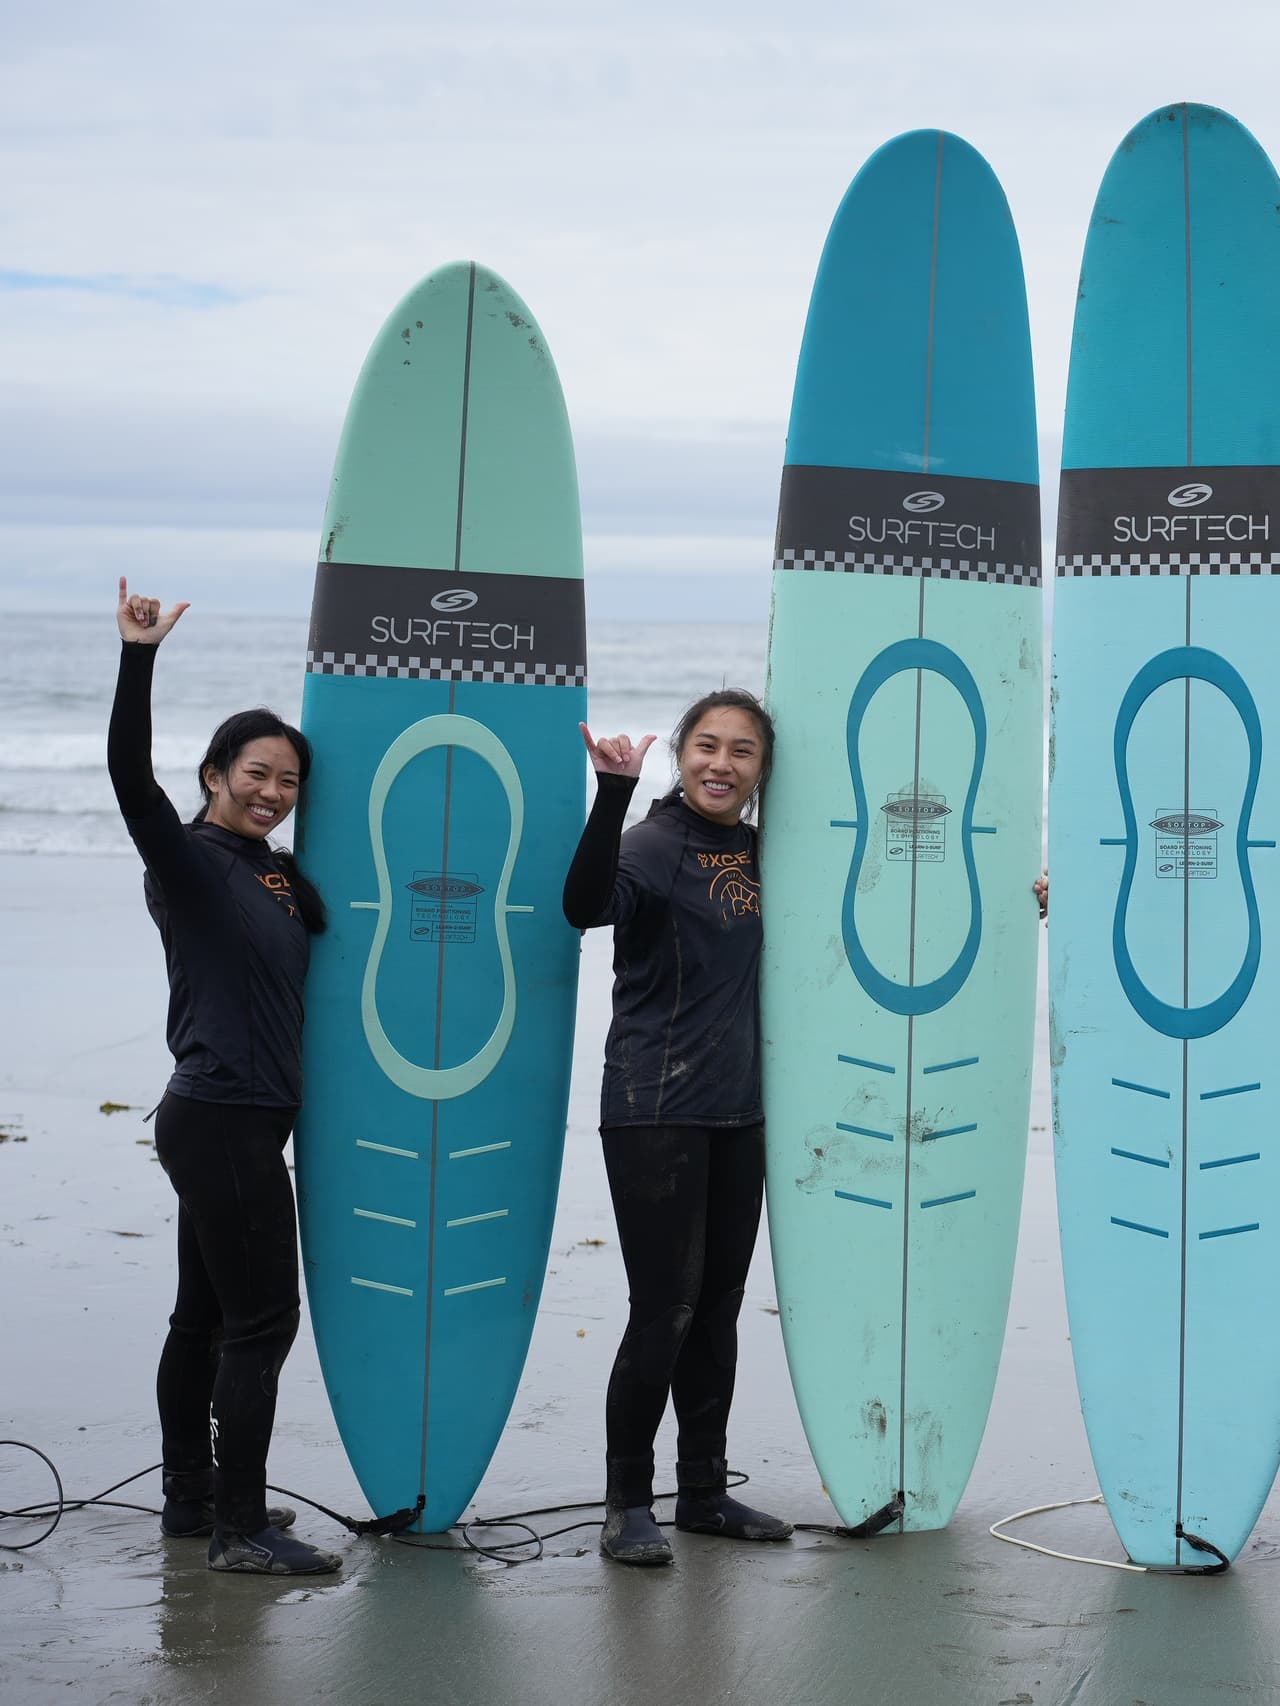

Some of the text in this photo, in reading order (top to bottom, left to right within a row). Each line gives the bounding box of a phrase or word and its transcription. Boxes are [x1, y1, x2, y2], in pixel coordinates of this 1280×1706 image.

[848, 516, 995, 551] SURFTECH
[1113, 514, 1269, 542] SURFTECH
[370, 616, 534, 651] SURFTECH
